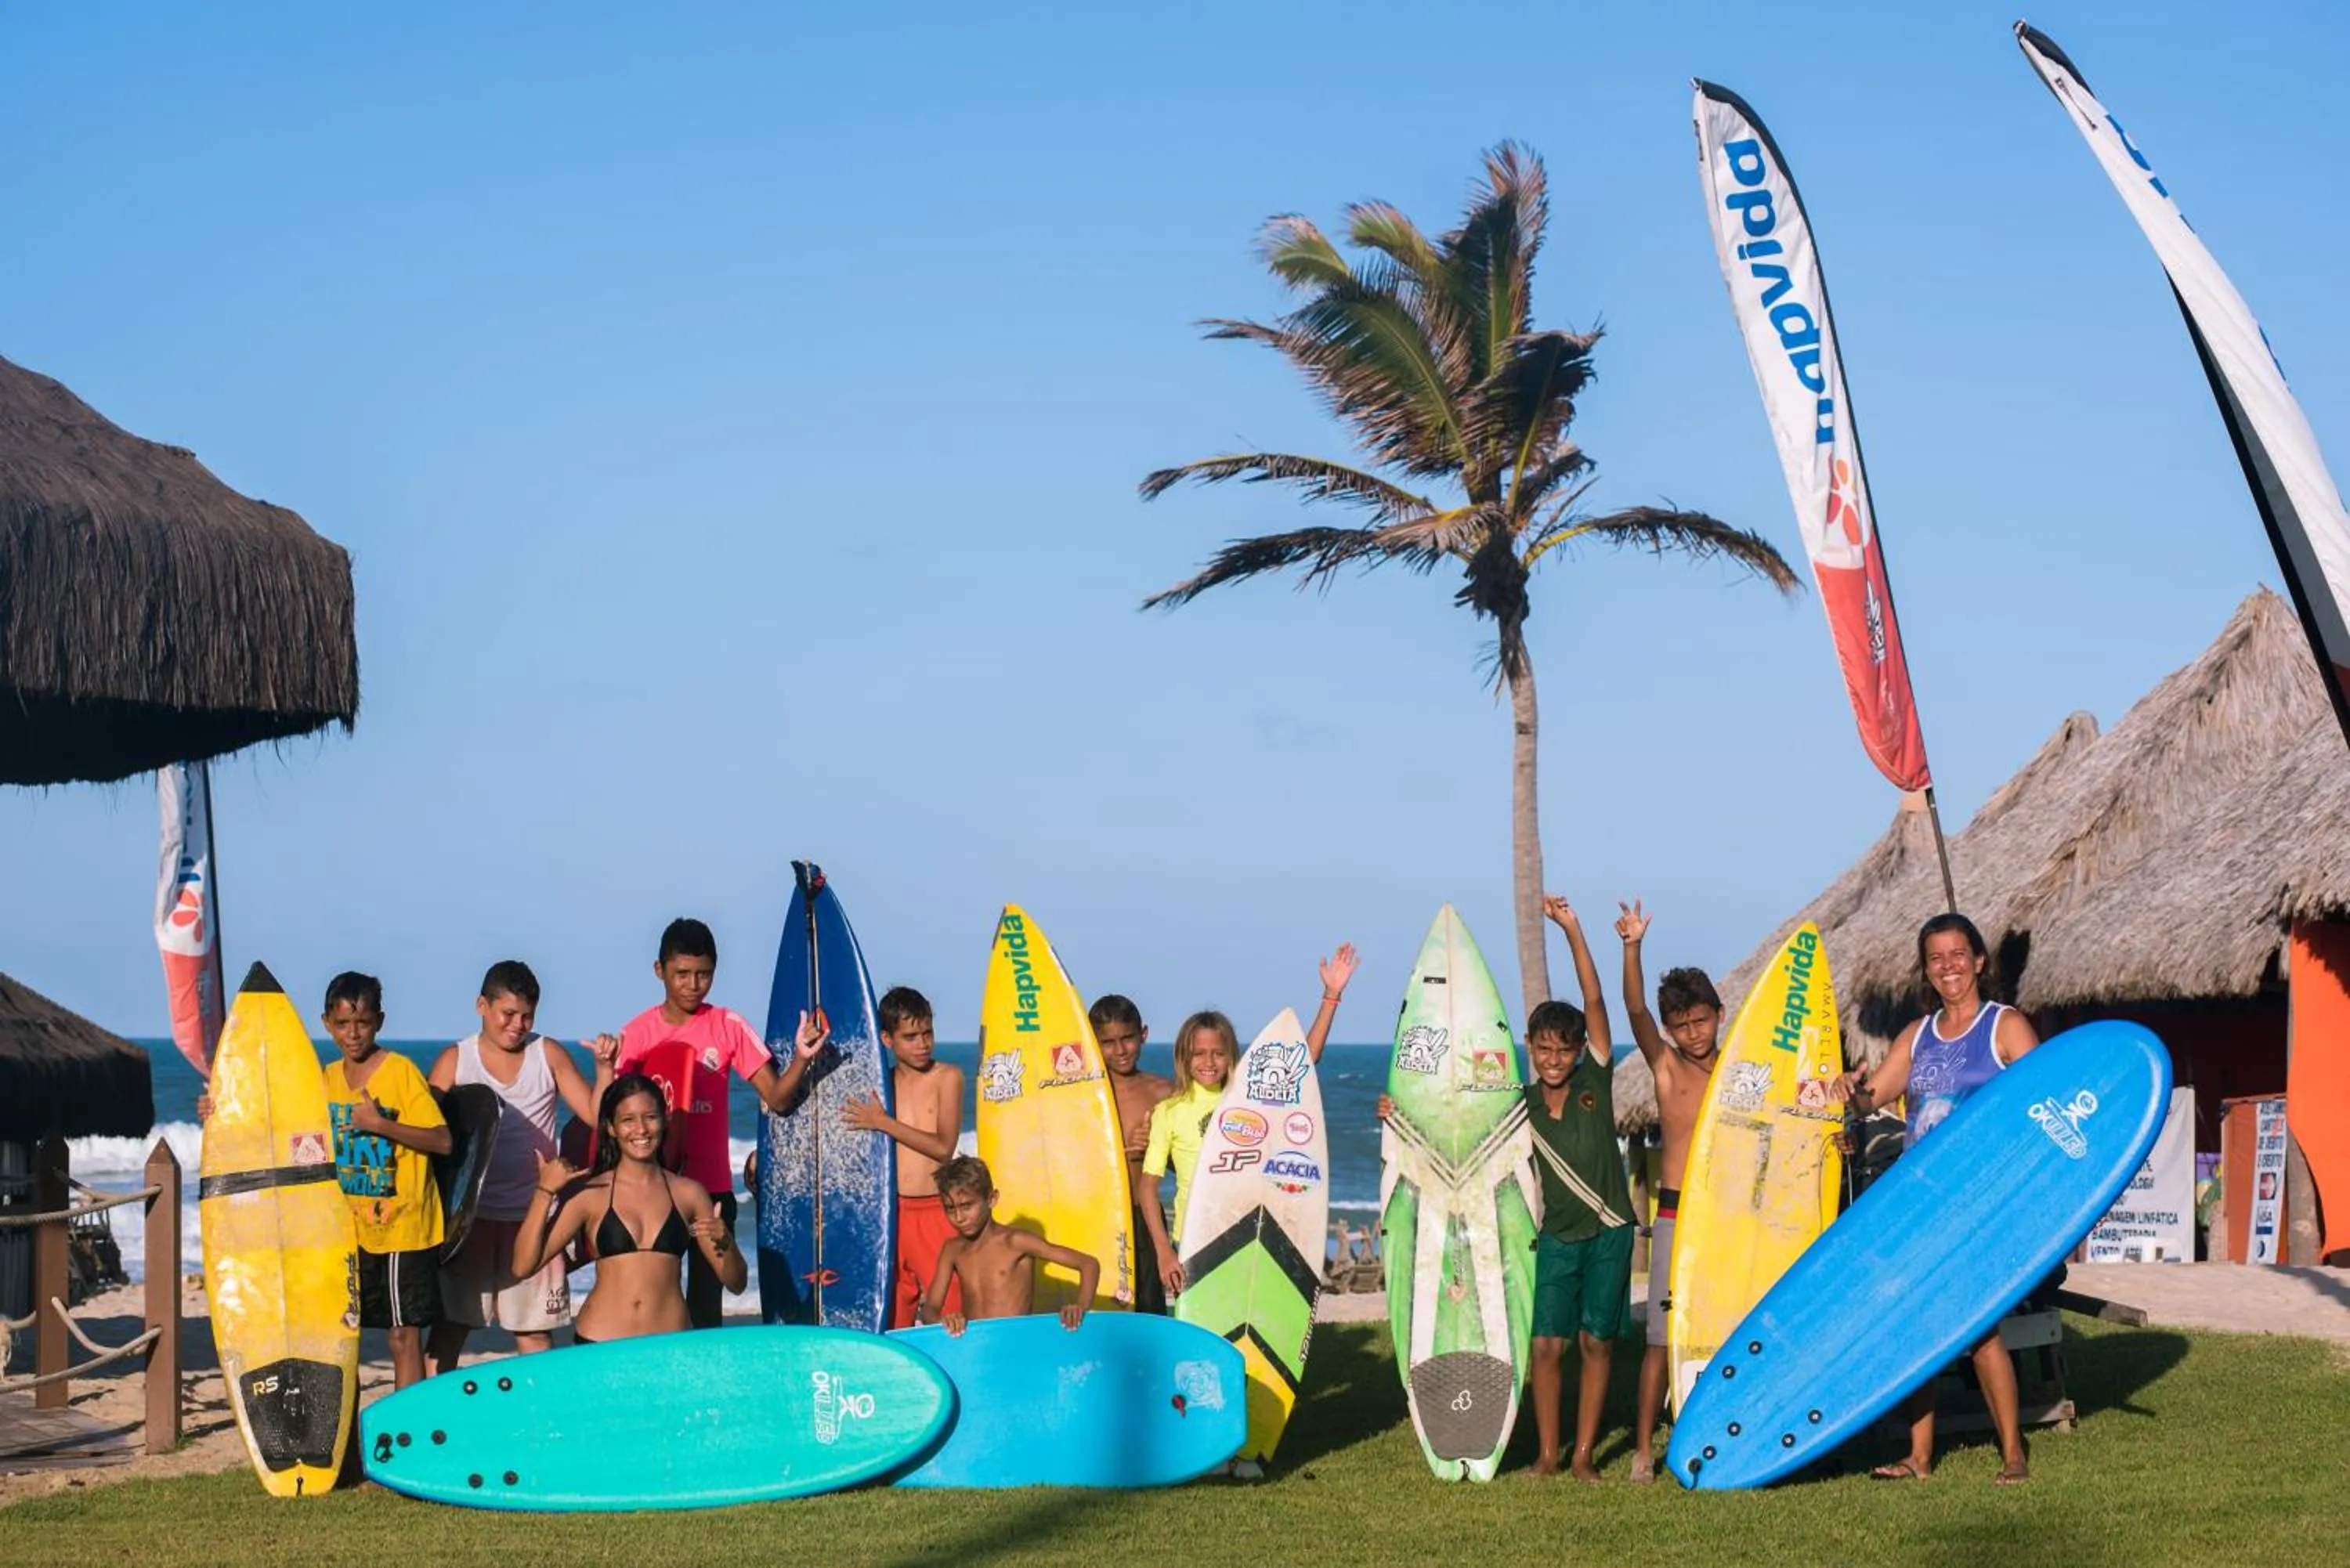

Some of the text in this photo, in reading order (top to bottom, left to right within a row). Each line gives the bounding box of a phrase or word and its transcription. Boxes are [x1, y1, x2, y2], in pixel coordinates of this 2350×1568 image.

[1001, 913, 1041, 1031] Hapvida
[1771, 930, 1818, 1053] Hapvida
[1263, 1158, 1321, 1180] ACACIA
[252, 1375, 279, 1396] RS
